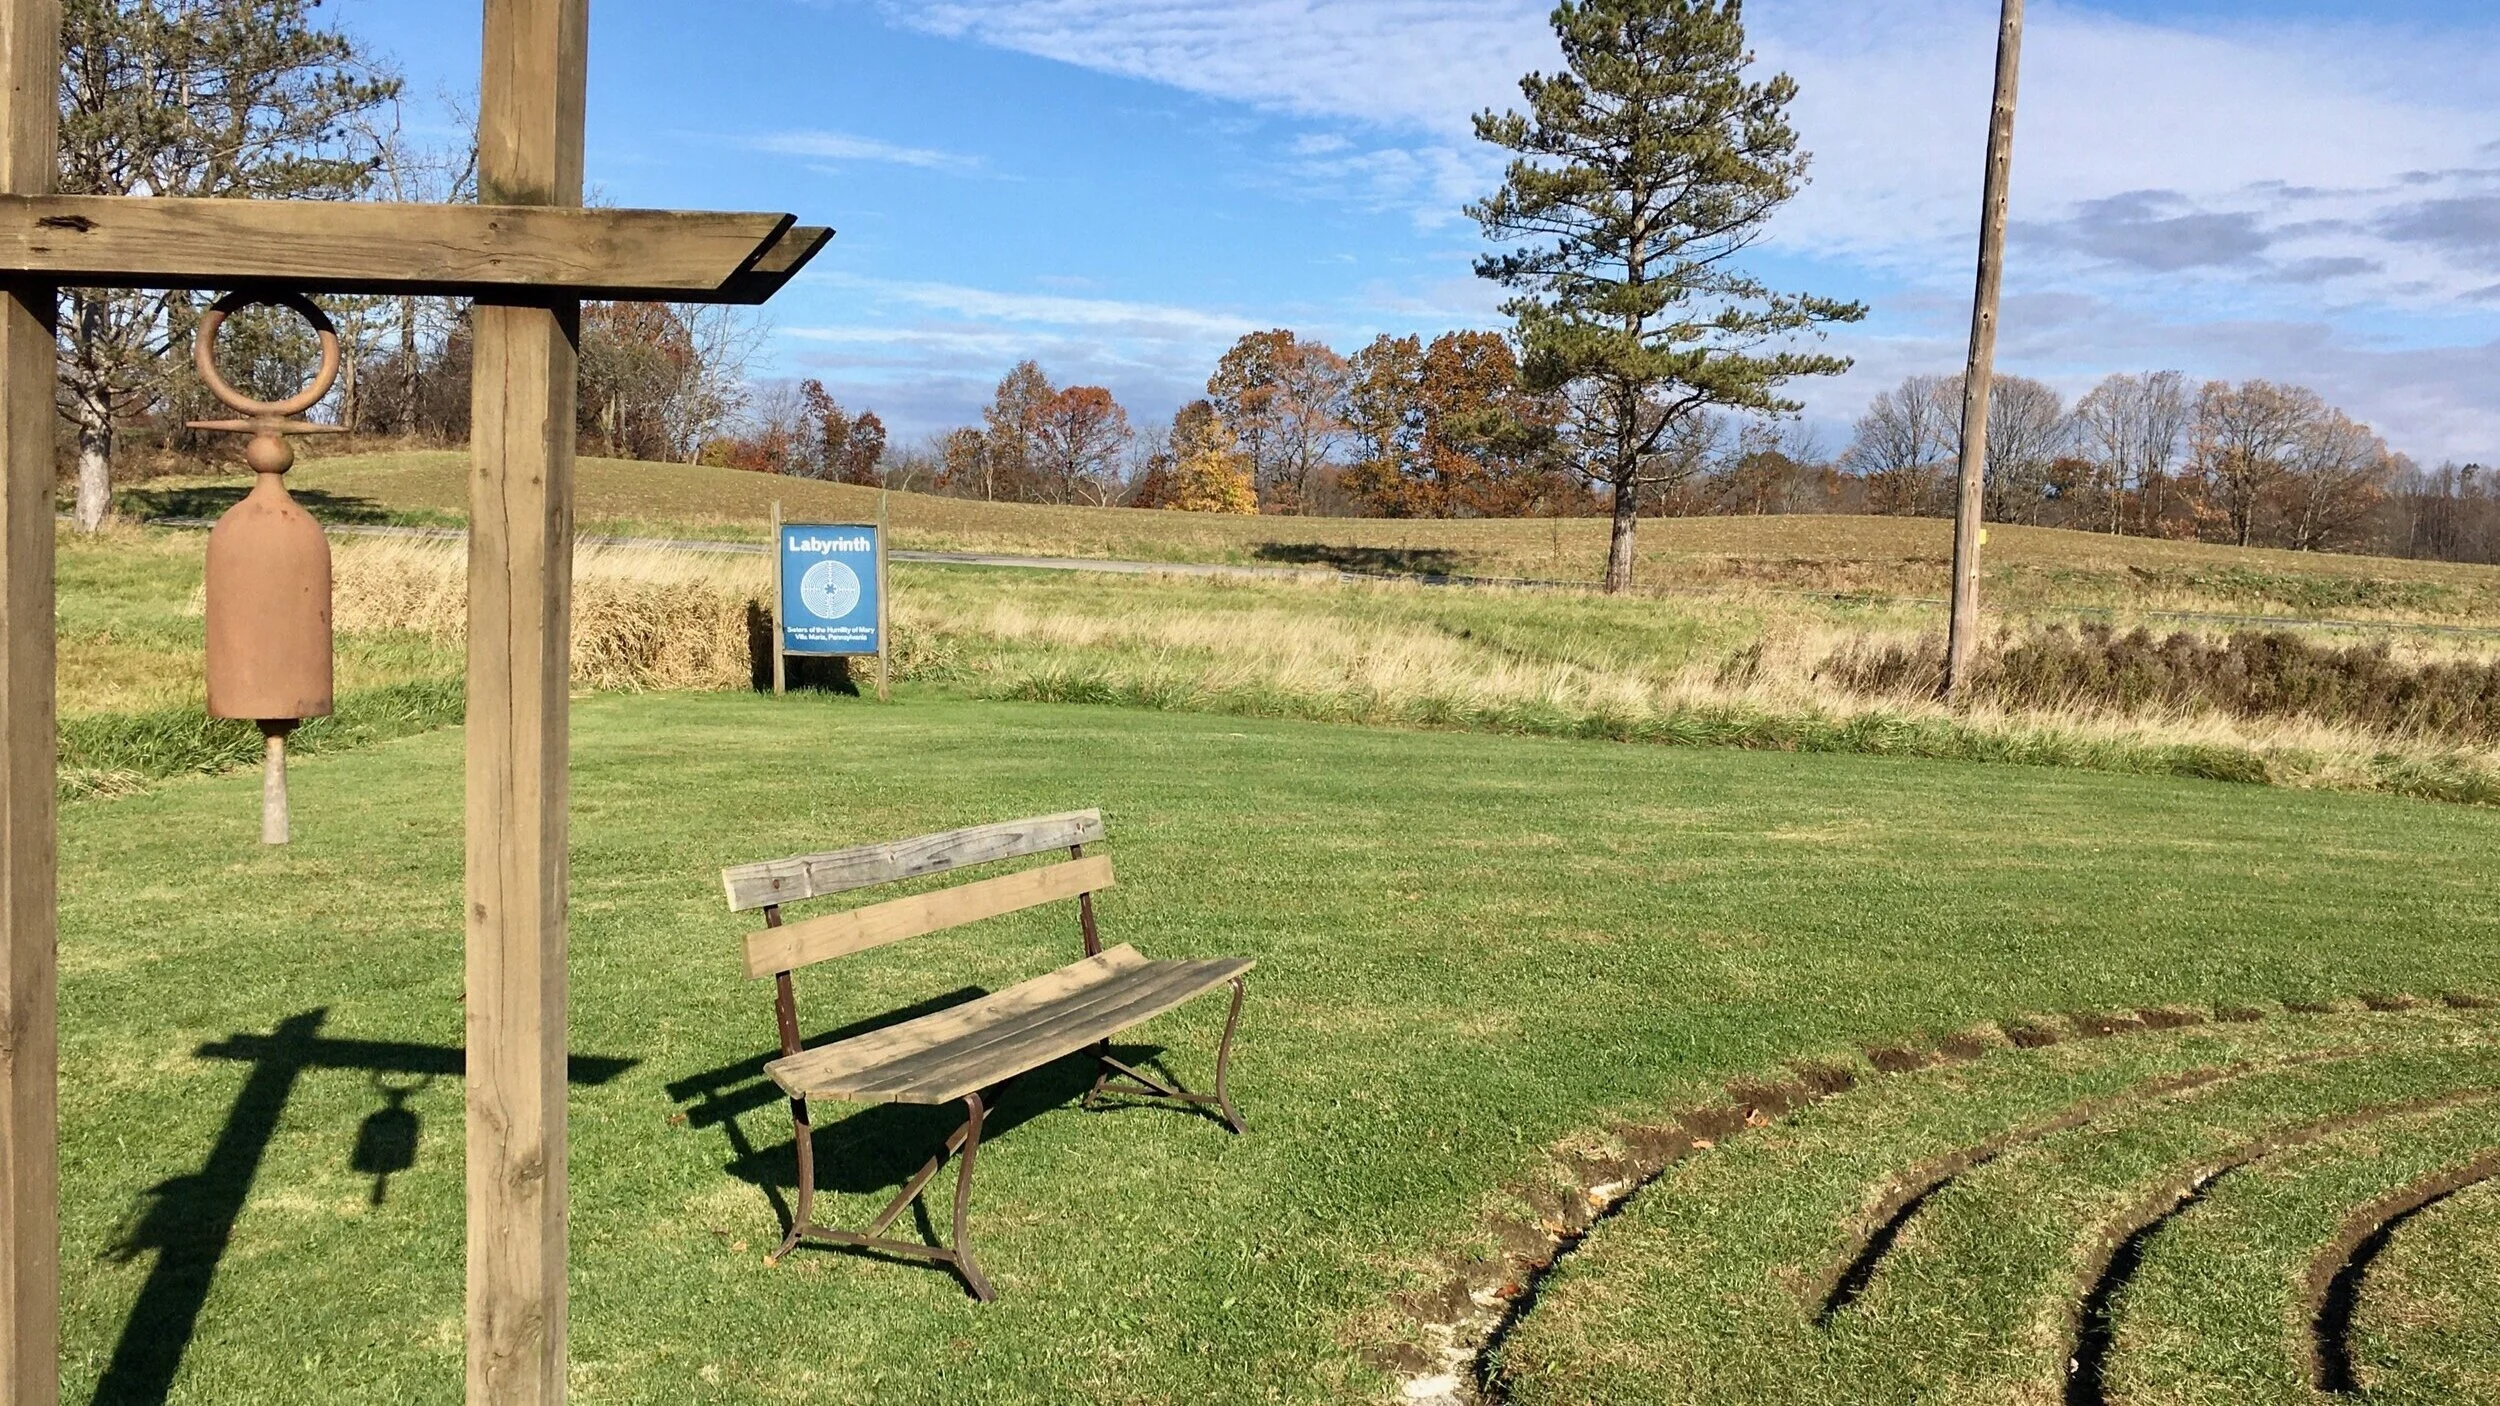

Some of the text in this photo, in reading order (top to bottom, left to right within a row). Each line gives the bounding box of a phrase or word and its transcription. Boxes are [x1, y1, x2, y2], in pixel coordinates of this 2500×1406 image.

[789, 536, 870, 555] Labyrinth
[815, 626, 826, 634] the
[859, 626, 875, 634] Mary
